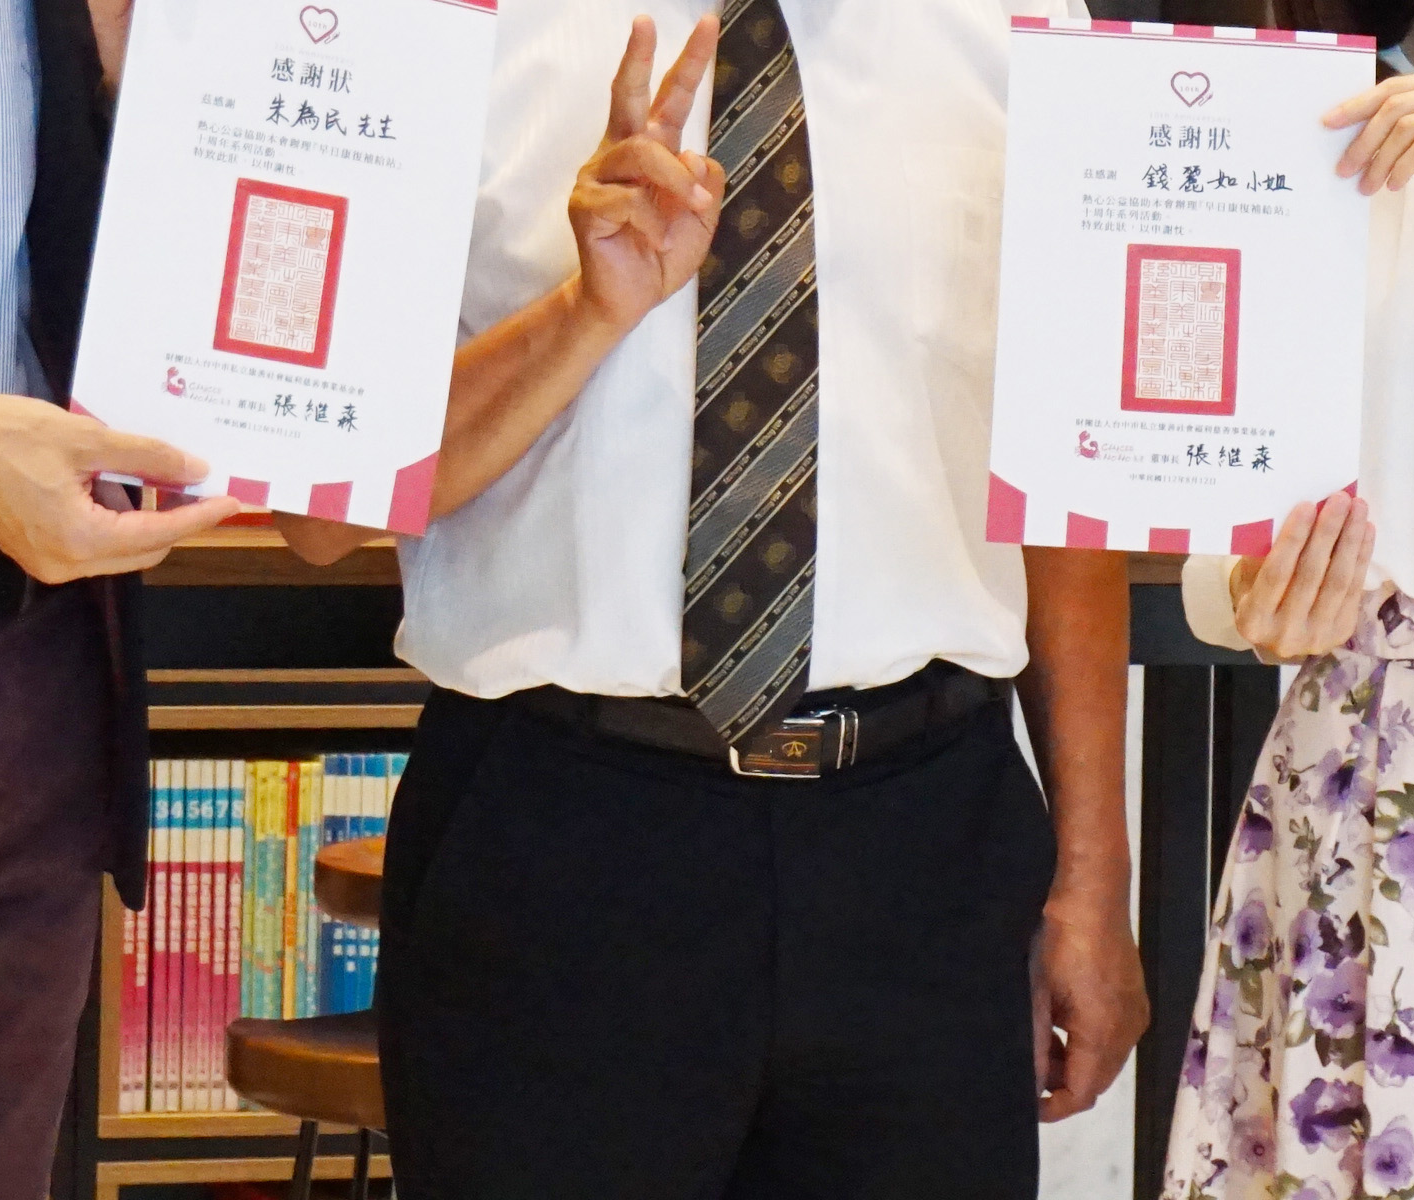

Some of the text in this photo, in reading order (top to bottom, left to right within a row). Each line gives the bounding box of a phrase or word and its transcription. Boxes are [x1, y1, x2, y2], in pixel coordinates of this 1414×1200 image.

[271, 57, 353, 94] 感謝狀
[265, 93, 397, 141] 朱為民 先生
[1148, 123, 1232, 151] 感謝狀
[1141, 162, 1294, 193] 錢麗如 小姐
[201, 800, 213, 818] 6
[216, 801, 229, 818] 7
